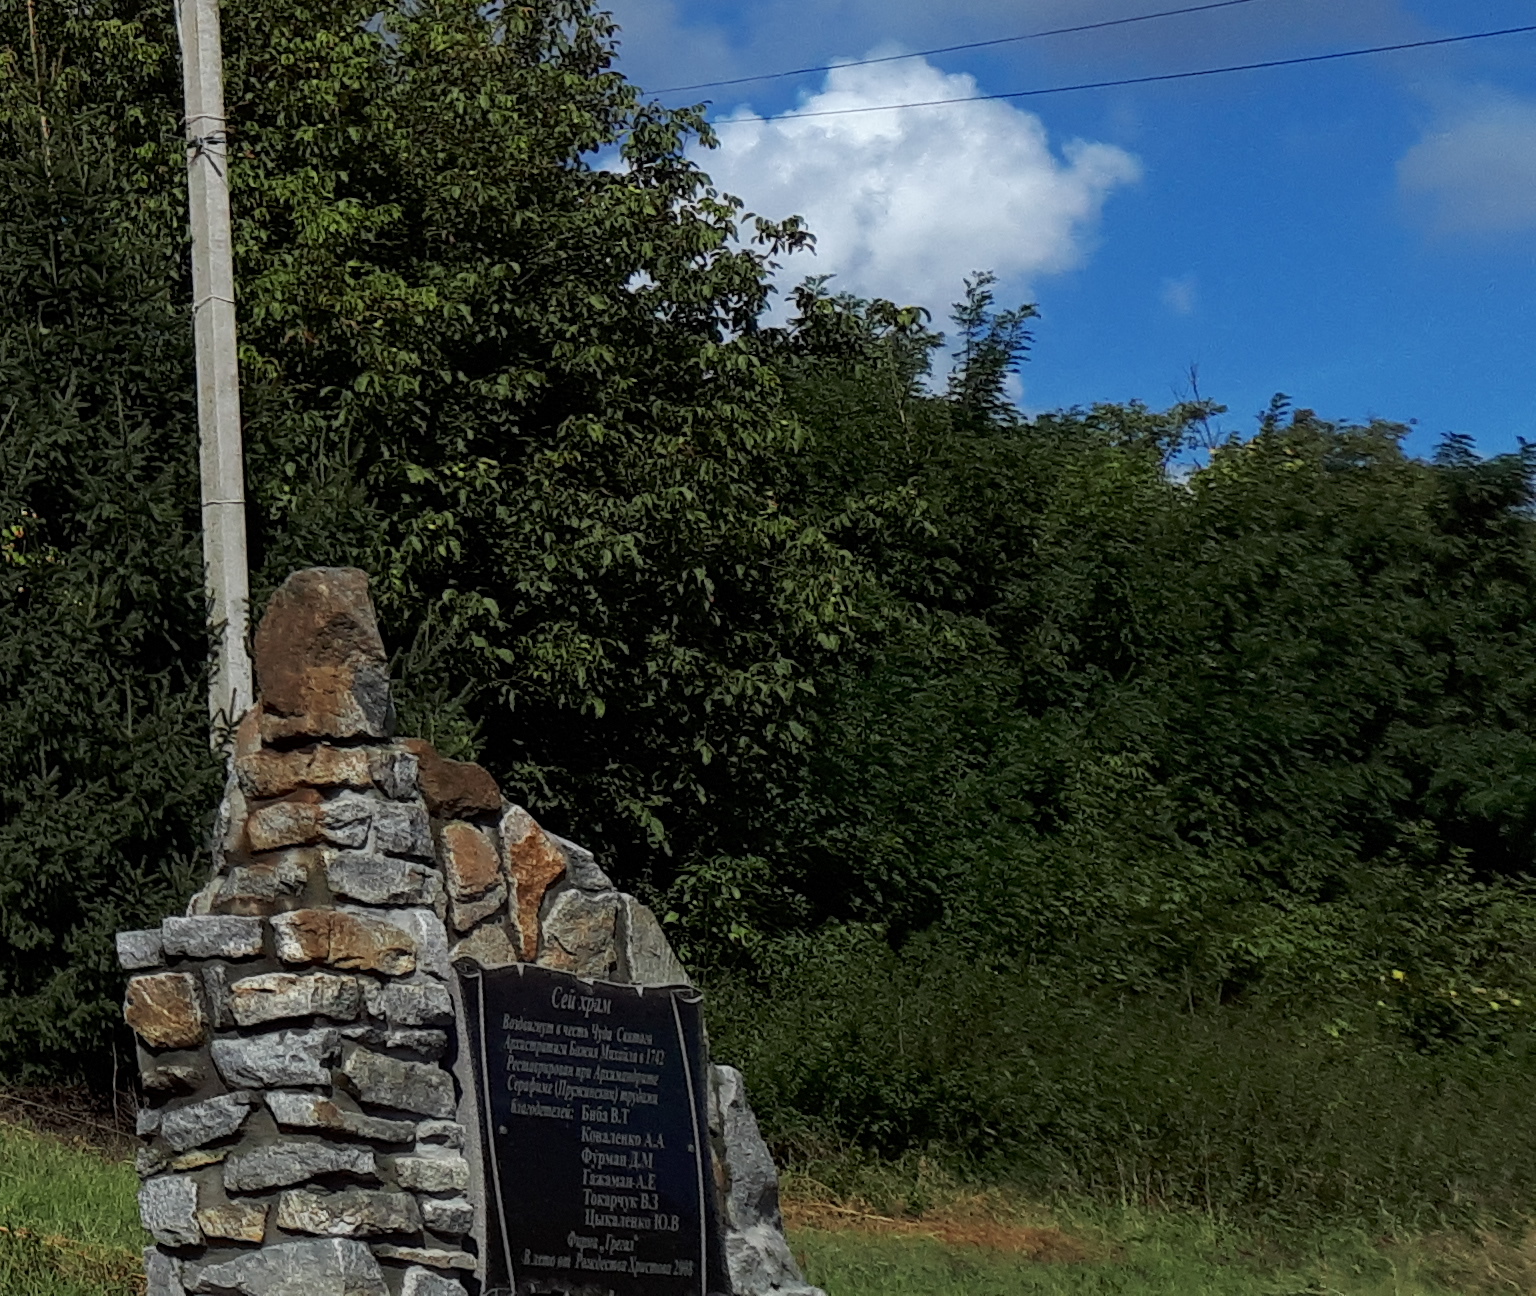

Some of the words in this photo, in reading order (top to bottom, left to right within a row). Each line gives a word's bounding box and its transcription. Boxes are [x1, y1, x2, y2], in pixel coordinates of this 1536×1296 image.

[551, 986, 576, 1010] Сей
[577, 995, 611, 1018] храм
[563, 1024, 589, 1039] честь
[507, 1074, 554, 1098] Серафиме
[575, 1066, 592, 1082] при
[610, 1106, 631, 1125] В.Т
[581, 1125, 642, 1147] Коваленко
[644, 1133, 666, 1149] А.А
[581, 1147, 627, 1170] Фурман
[628, 1150, 654, 1170] Д.М
[582, 1188, 639, 1213] Токарчук
[640, 1192, 659, 1211] В.З
[584, 1208, 651, 1229] Цыкаленко
[653, 1213, 680, 1232] Ю.В
[522, 1248, 531, 1265] В
[574, 1252, 628, 1273] Рождества
[628, 1256, 672, 1278] Христова
